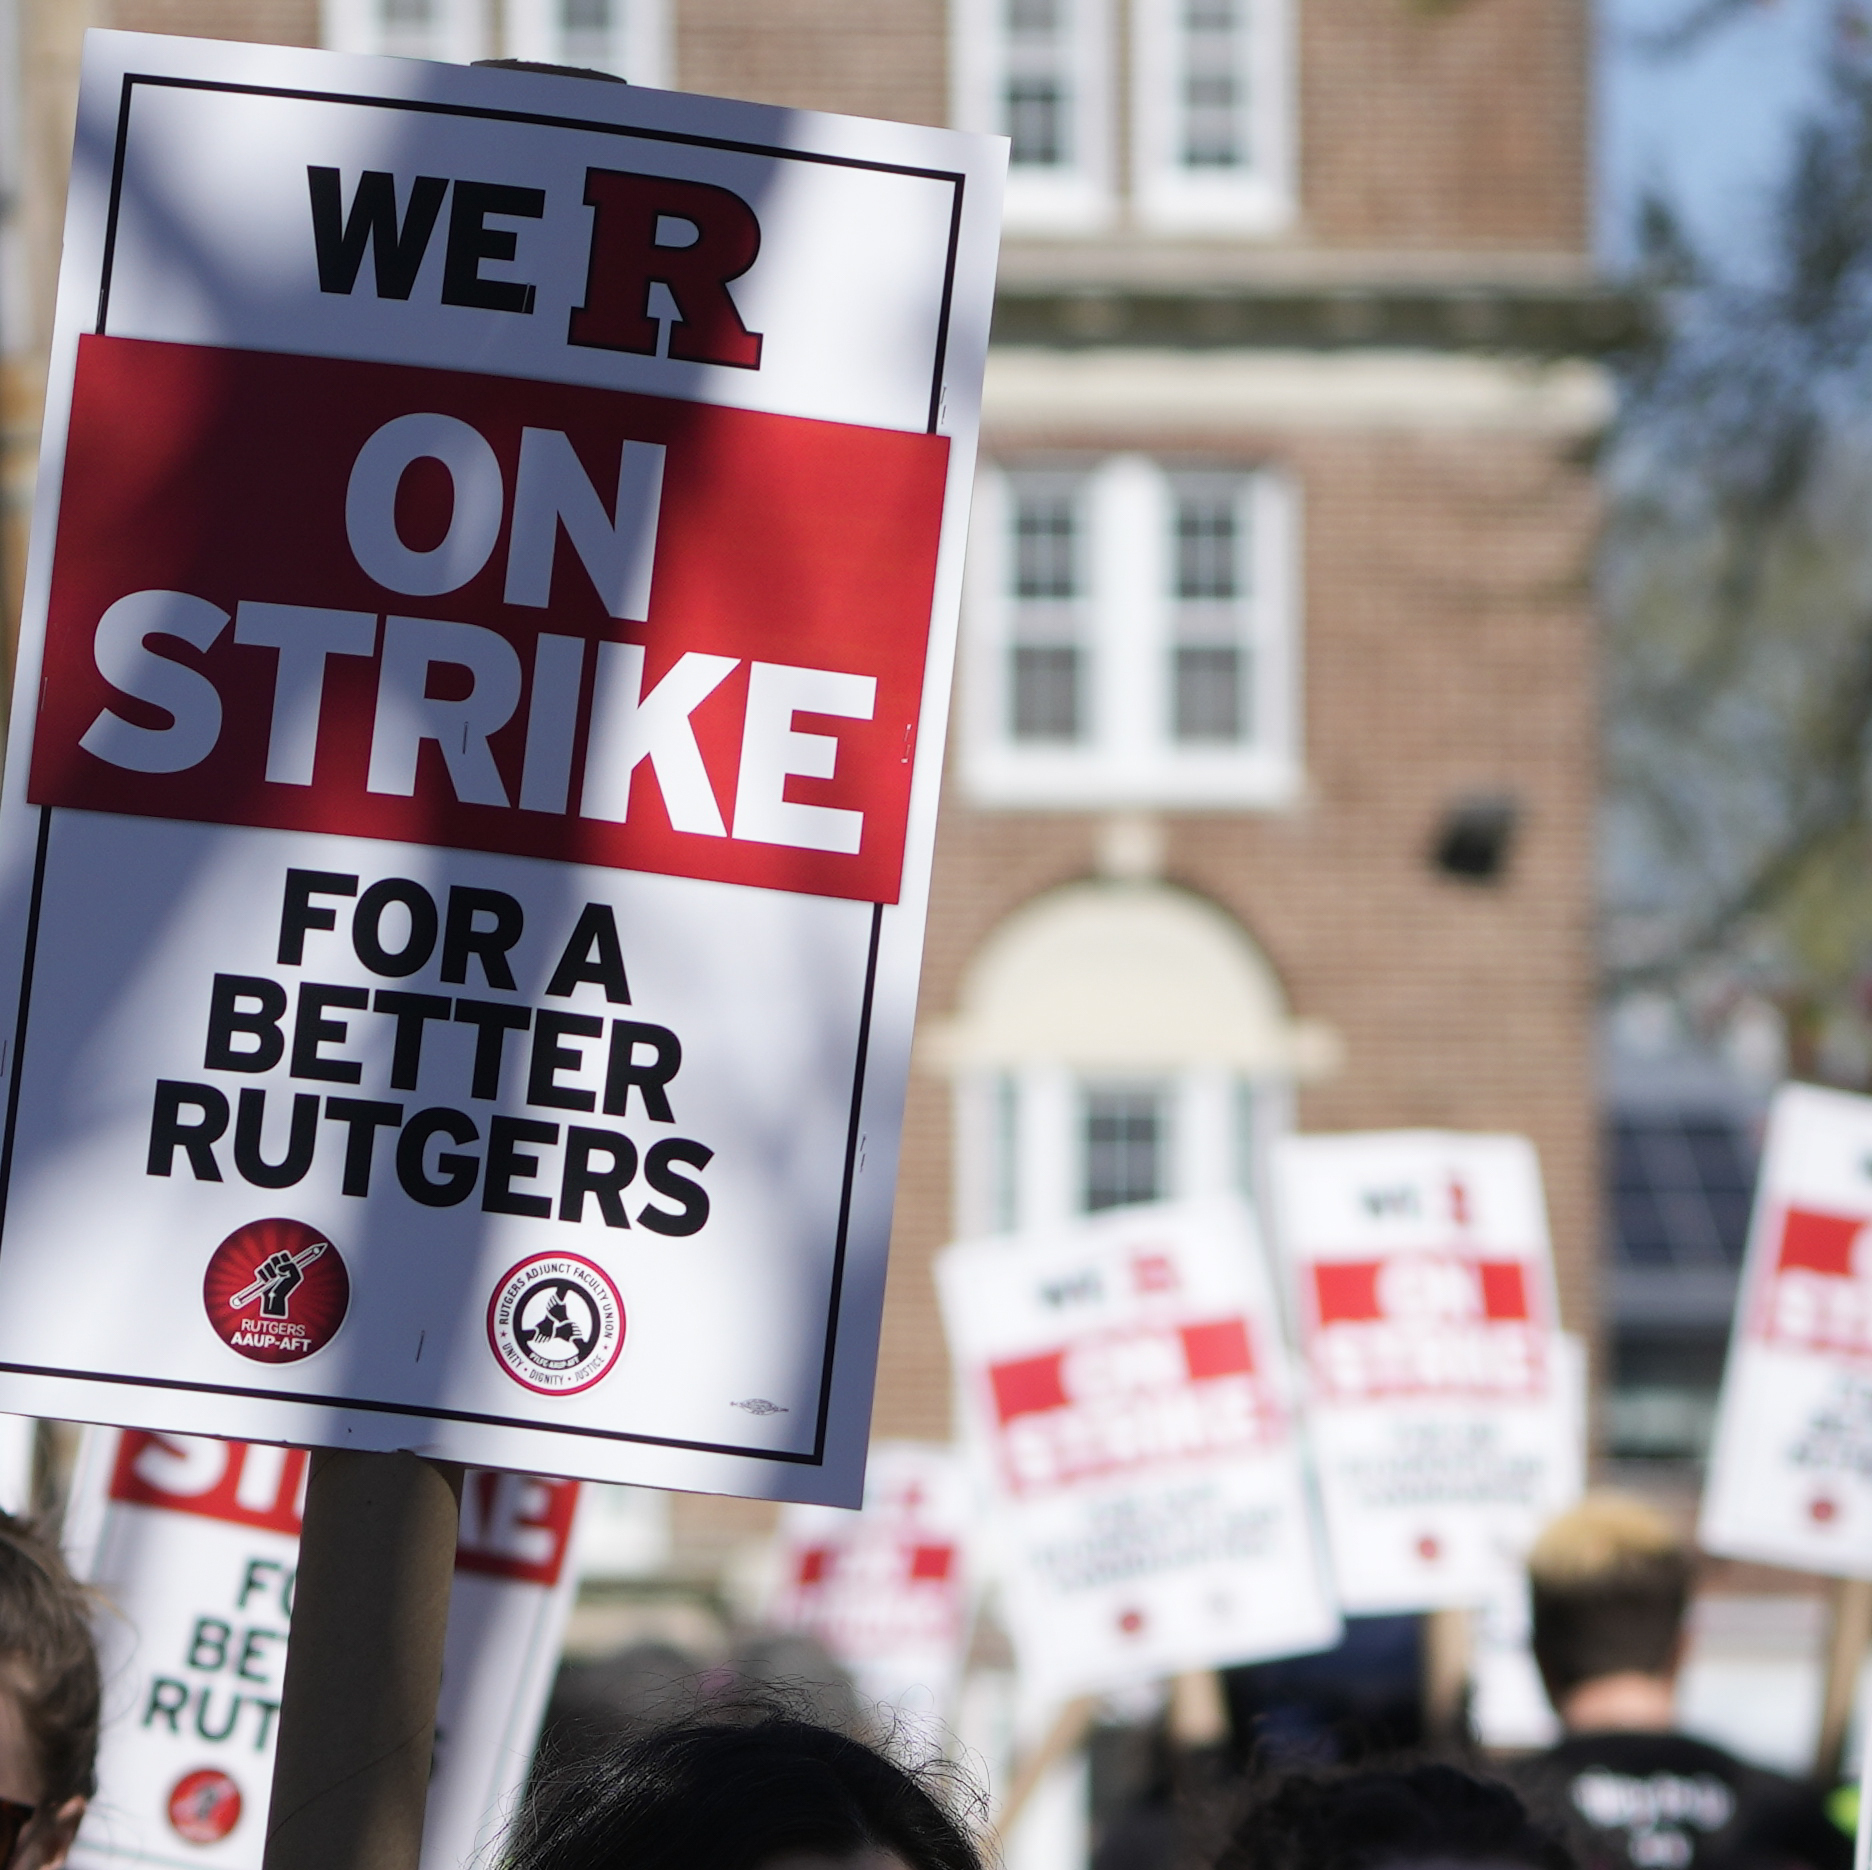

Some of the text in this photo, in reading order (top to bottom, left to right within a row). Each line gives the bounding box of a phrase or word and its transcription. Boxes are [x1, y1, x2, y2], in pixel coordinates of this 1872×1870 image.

[306, 165, 764, 371] WE R
[344, 411, 666, 622] ON
[77, 588, 877, 855] STRIKE
[276, 867, 632, 1006] FOR A
[203, 973, 682, 1124] BETTER
[146, 1078, 714, 1238] RUTGERS
[231, 1332, 312, 1352] AAUP-AFT
[241, 1319, 305, 1337] RUTGERS
[499, 1263, 615, 1339] RUTGERS ADJUNCT FACULTY UNION
[502, 1342, 605, 1386] UNITY DIGNITY JUSTICE
